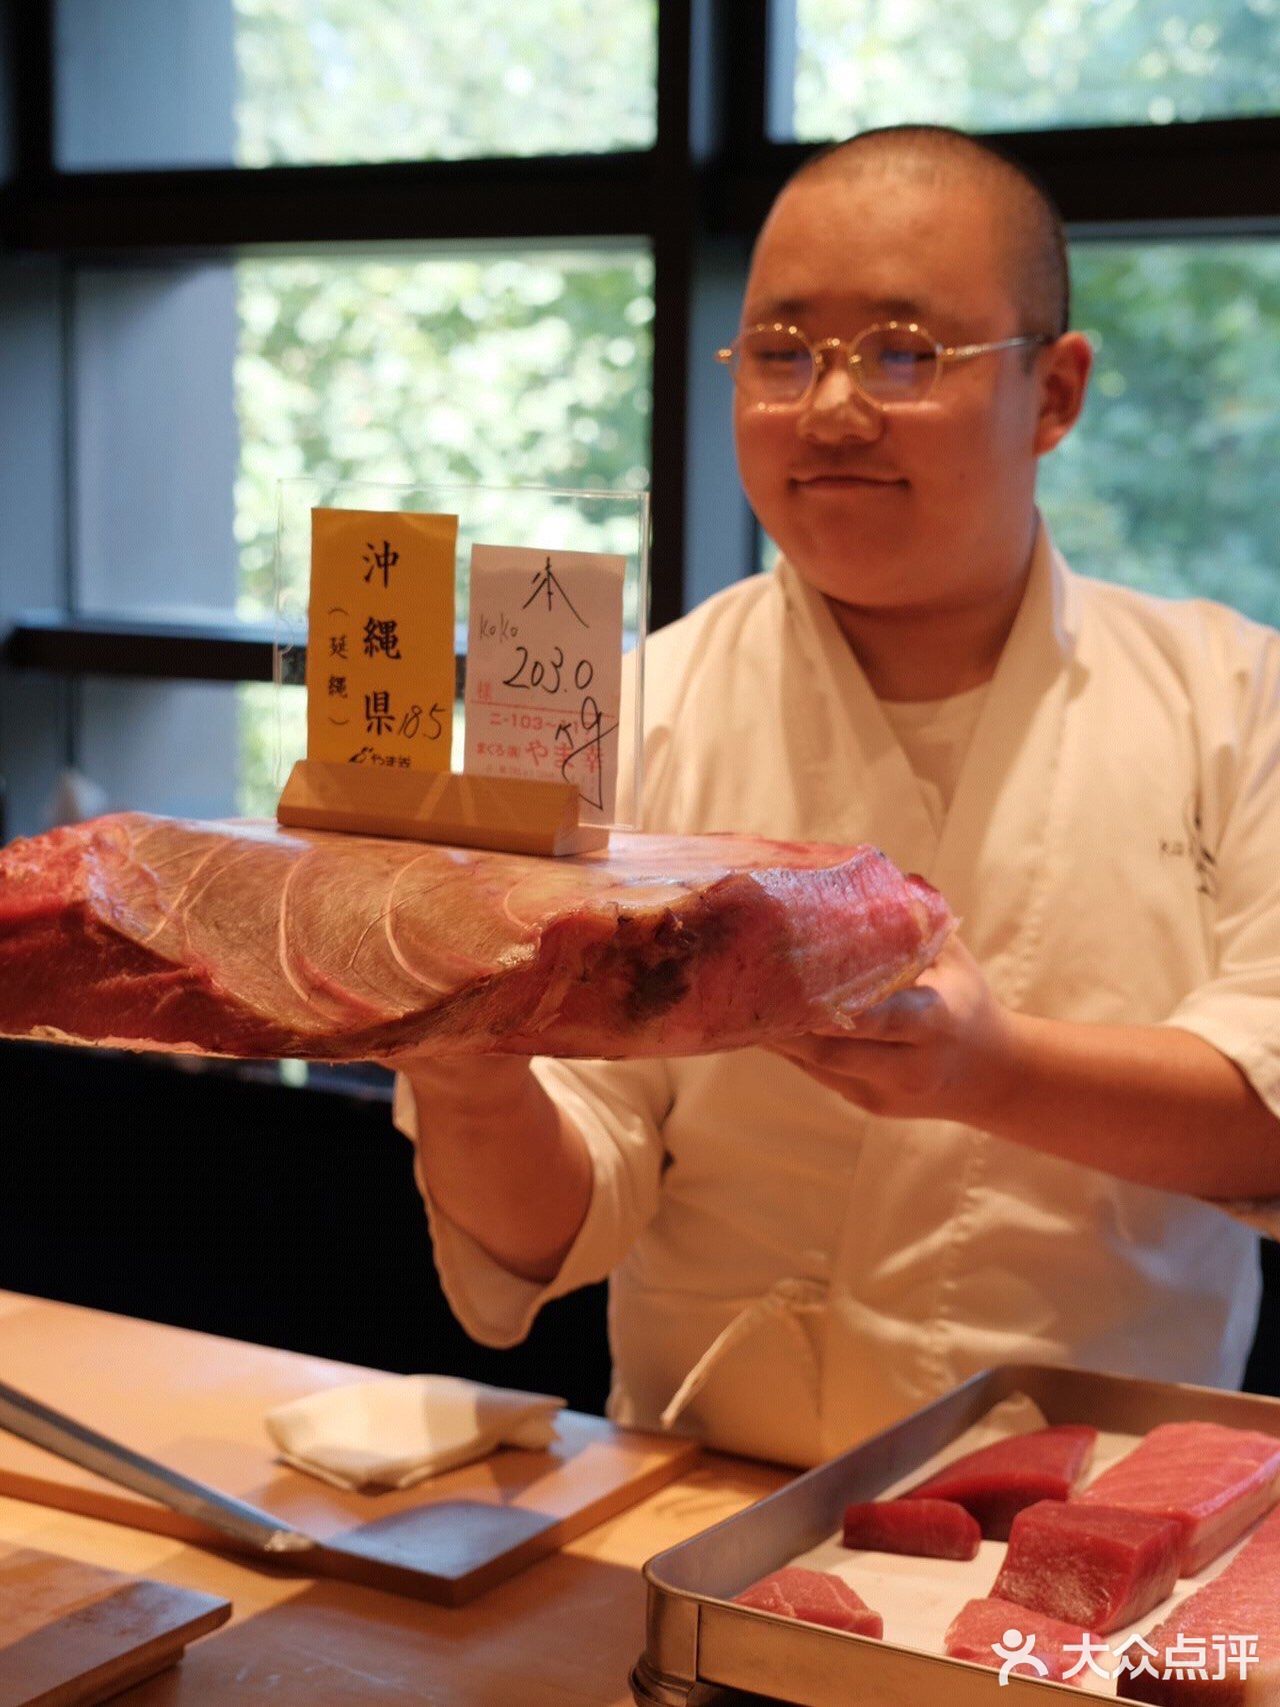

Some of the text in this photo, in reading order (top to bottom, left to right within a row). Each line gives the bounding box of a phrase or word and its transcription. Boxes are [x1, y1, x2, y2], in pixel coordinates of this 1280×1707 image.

[362, 540, 402, 736] 沖縄県
[502, 646, 594, 695] 203.0
[399, 702, 446, 741] 185
